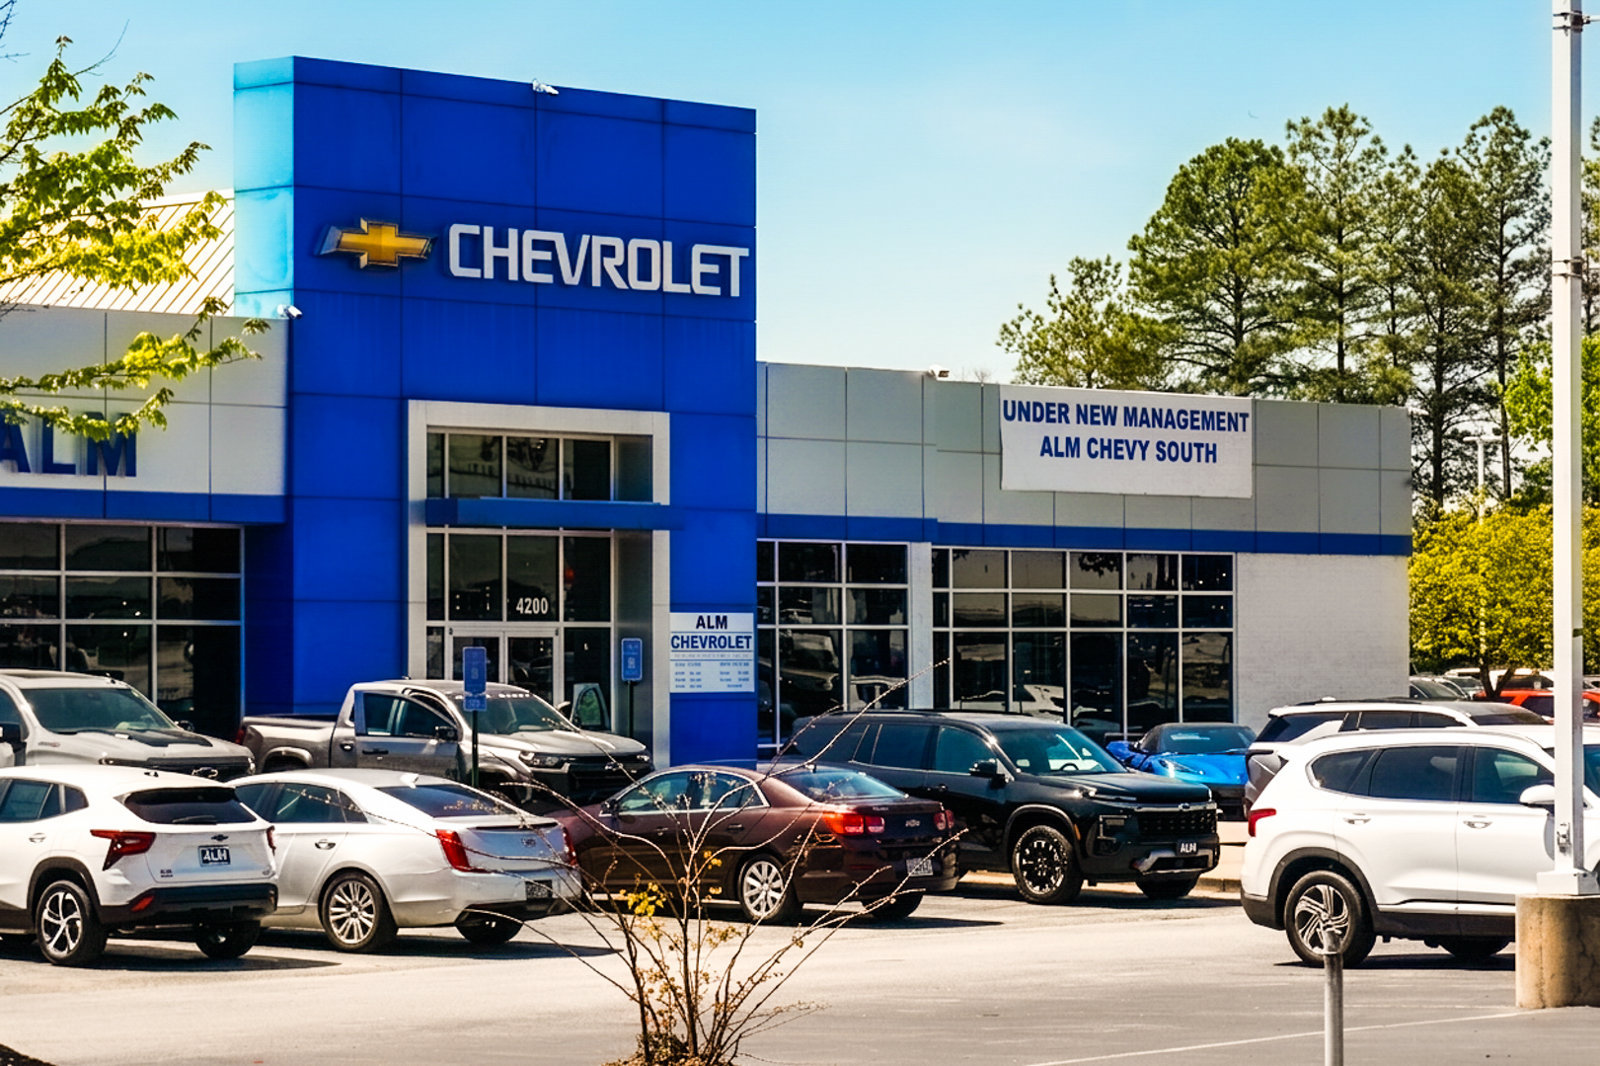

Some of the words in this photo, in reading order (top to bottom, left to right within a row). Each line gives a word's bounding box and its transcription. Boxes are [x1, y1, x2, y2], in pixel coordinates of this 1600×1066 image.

[449, 223, 750, 297] CHEVROLET
[1003, 400, 1070, 424] UNDER
[1076, 404, 1118, 427] NEW
[1123, 406, 1249, 432] MANAGEMENT
[1040, 436, 1081, 459] ALM
[1087, 437, 1150, 461] CHEVY
[1155, 440, 1218, 464] SOUTH
[515, 597, 549, 615] 4200
[696, 615, 728, 629] ALM
[671, 635, 752, 649] CHEVROLET
